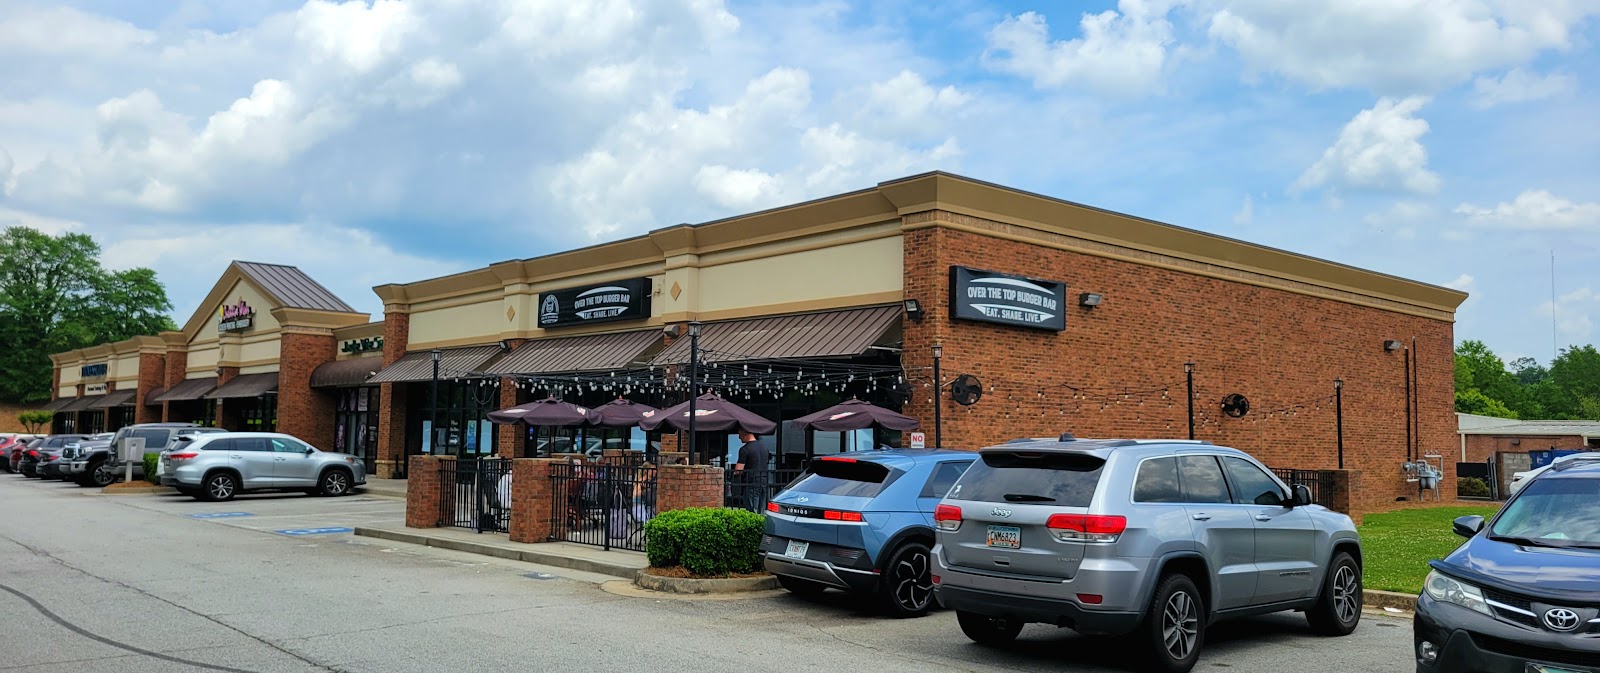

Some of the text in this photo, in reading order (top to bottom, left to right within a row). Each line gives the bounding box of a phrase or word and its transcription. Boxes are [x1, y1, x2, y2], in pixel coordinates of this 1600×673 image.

[574, 294, 630, 309] OVER THE TOP BURGER BAR
[968, 287, 1057, 310] OVER THE TOP BURGER BAR
[986, 307, 1041, 323] EAT. SHARE. LIVE.
[991, 507, 1012, 518] Jeep
